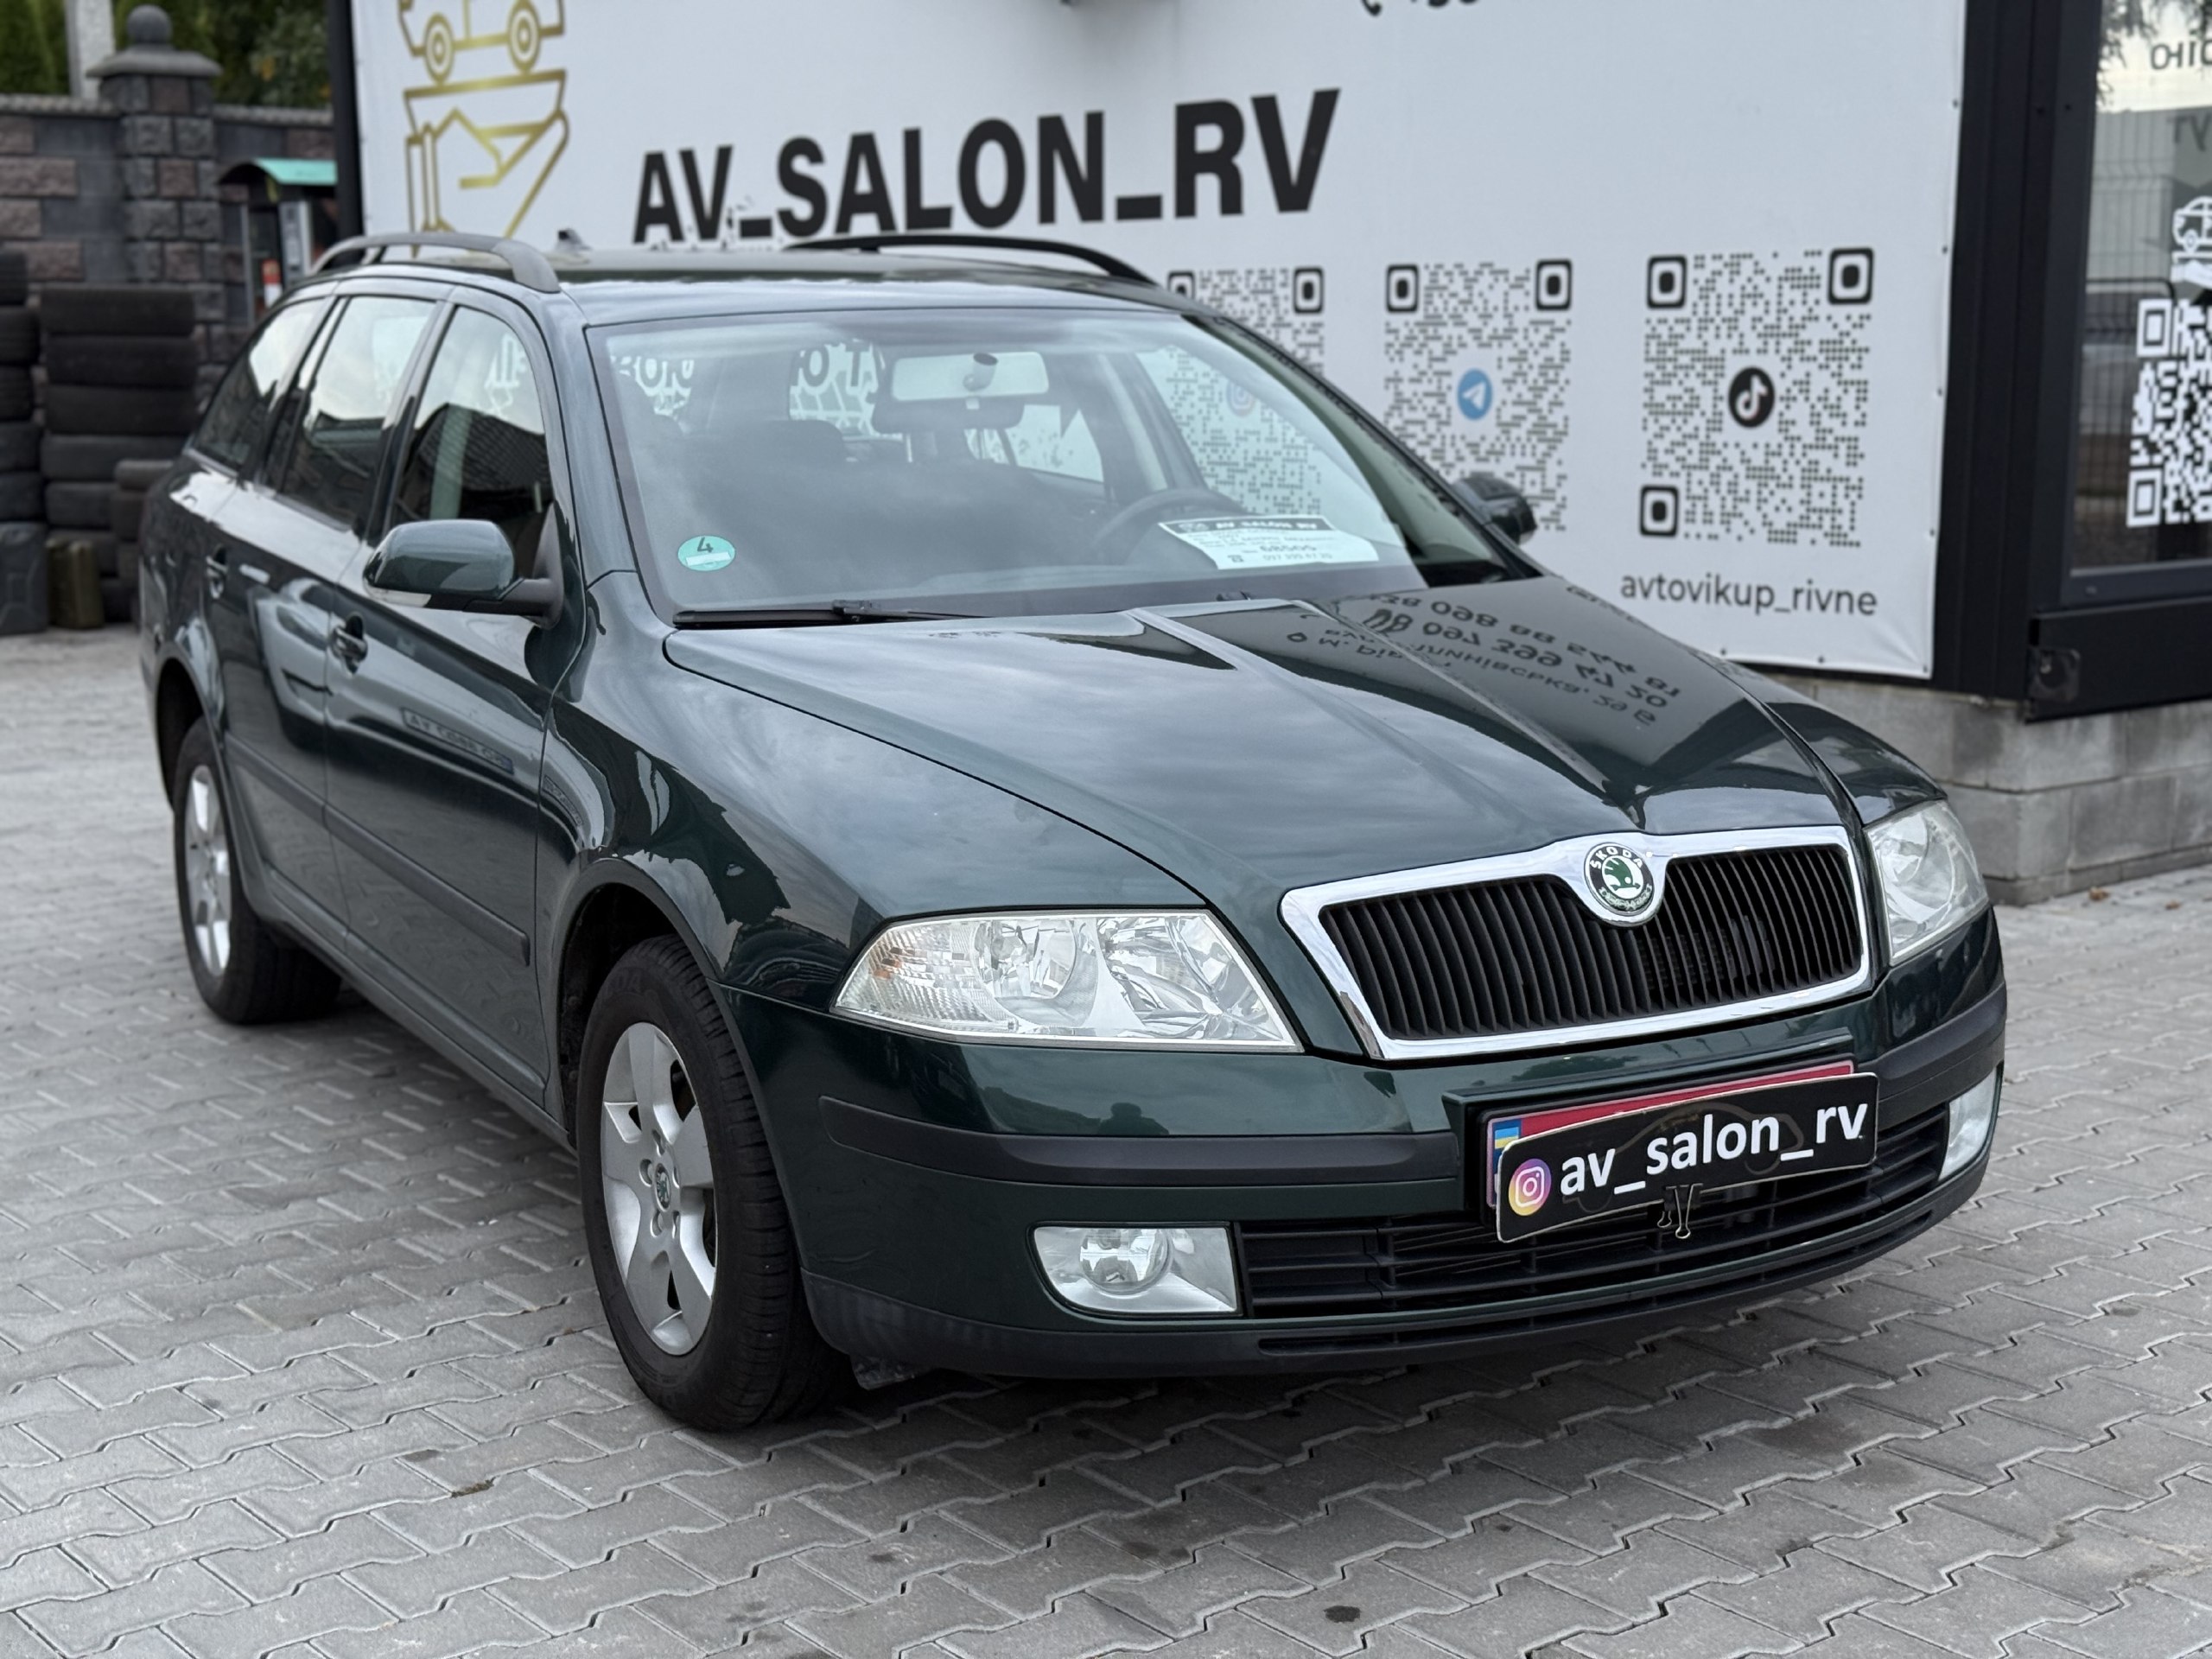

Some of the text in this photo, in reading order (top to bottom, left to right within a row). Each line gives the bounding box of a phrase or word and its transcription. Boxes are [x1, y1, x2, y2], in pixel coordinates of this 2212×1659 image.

[633, 88, 1341, 245] AV_SALON_RV
[696, 537, 714, 553] 4
[1620, 572, 1878, 616] avtovikup_rivne
[1560, 1103, 1868, 1195] av_salon_rv
